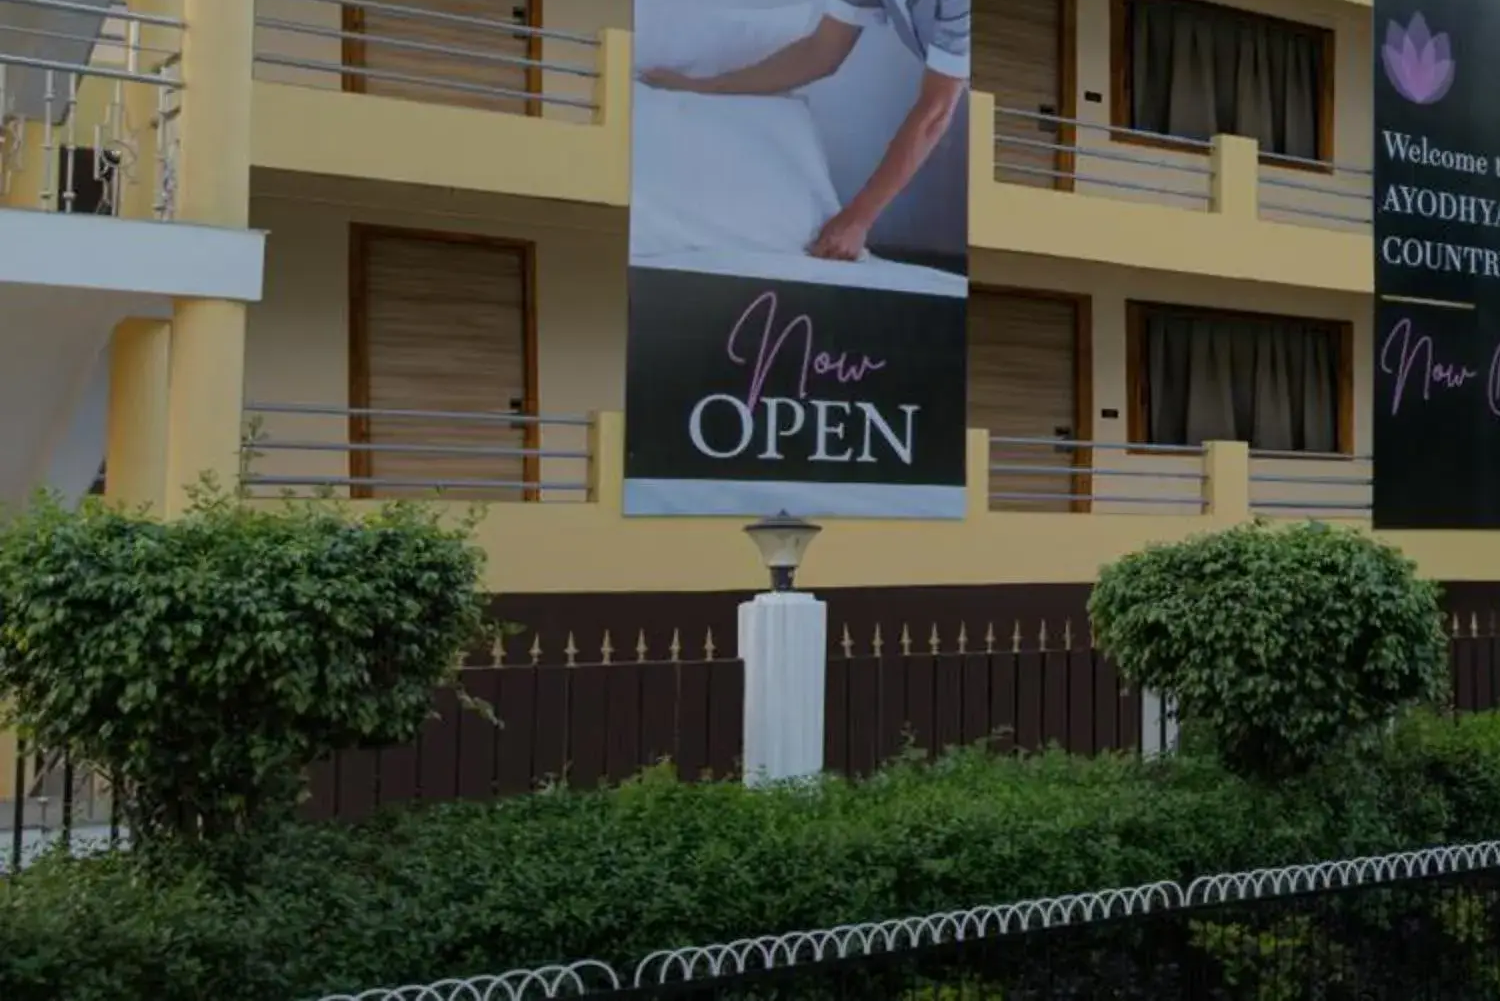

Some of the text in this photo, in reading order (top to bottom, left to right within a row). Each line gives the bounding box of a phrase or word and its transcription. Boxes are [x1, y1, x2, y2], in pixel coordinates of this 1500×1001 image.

[1382, 130, 1487, 175] Welcome
[728, 291, 886, 413] Now
[1381, 318, 1477, 415] Now
[689, 393, 921, 465] OPEN
